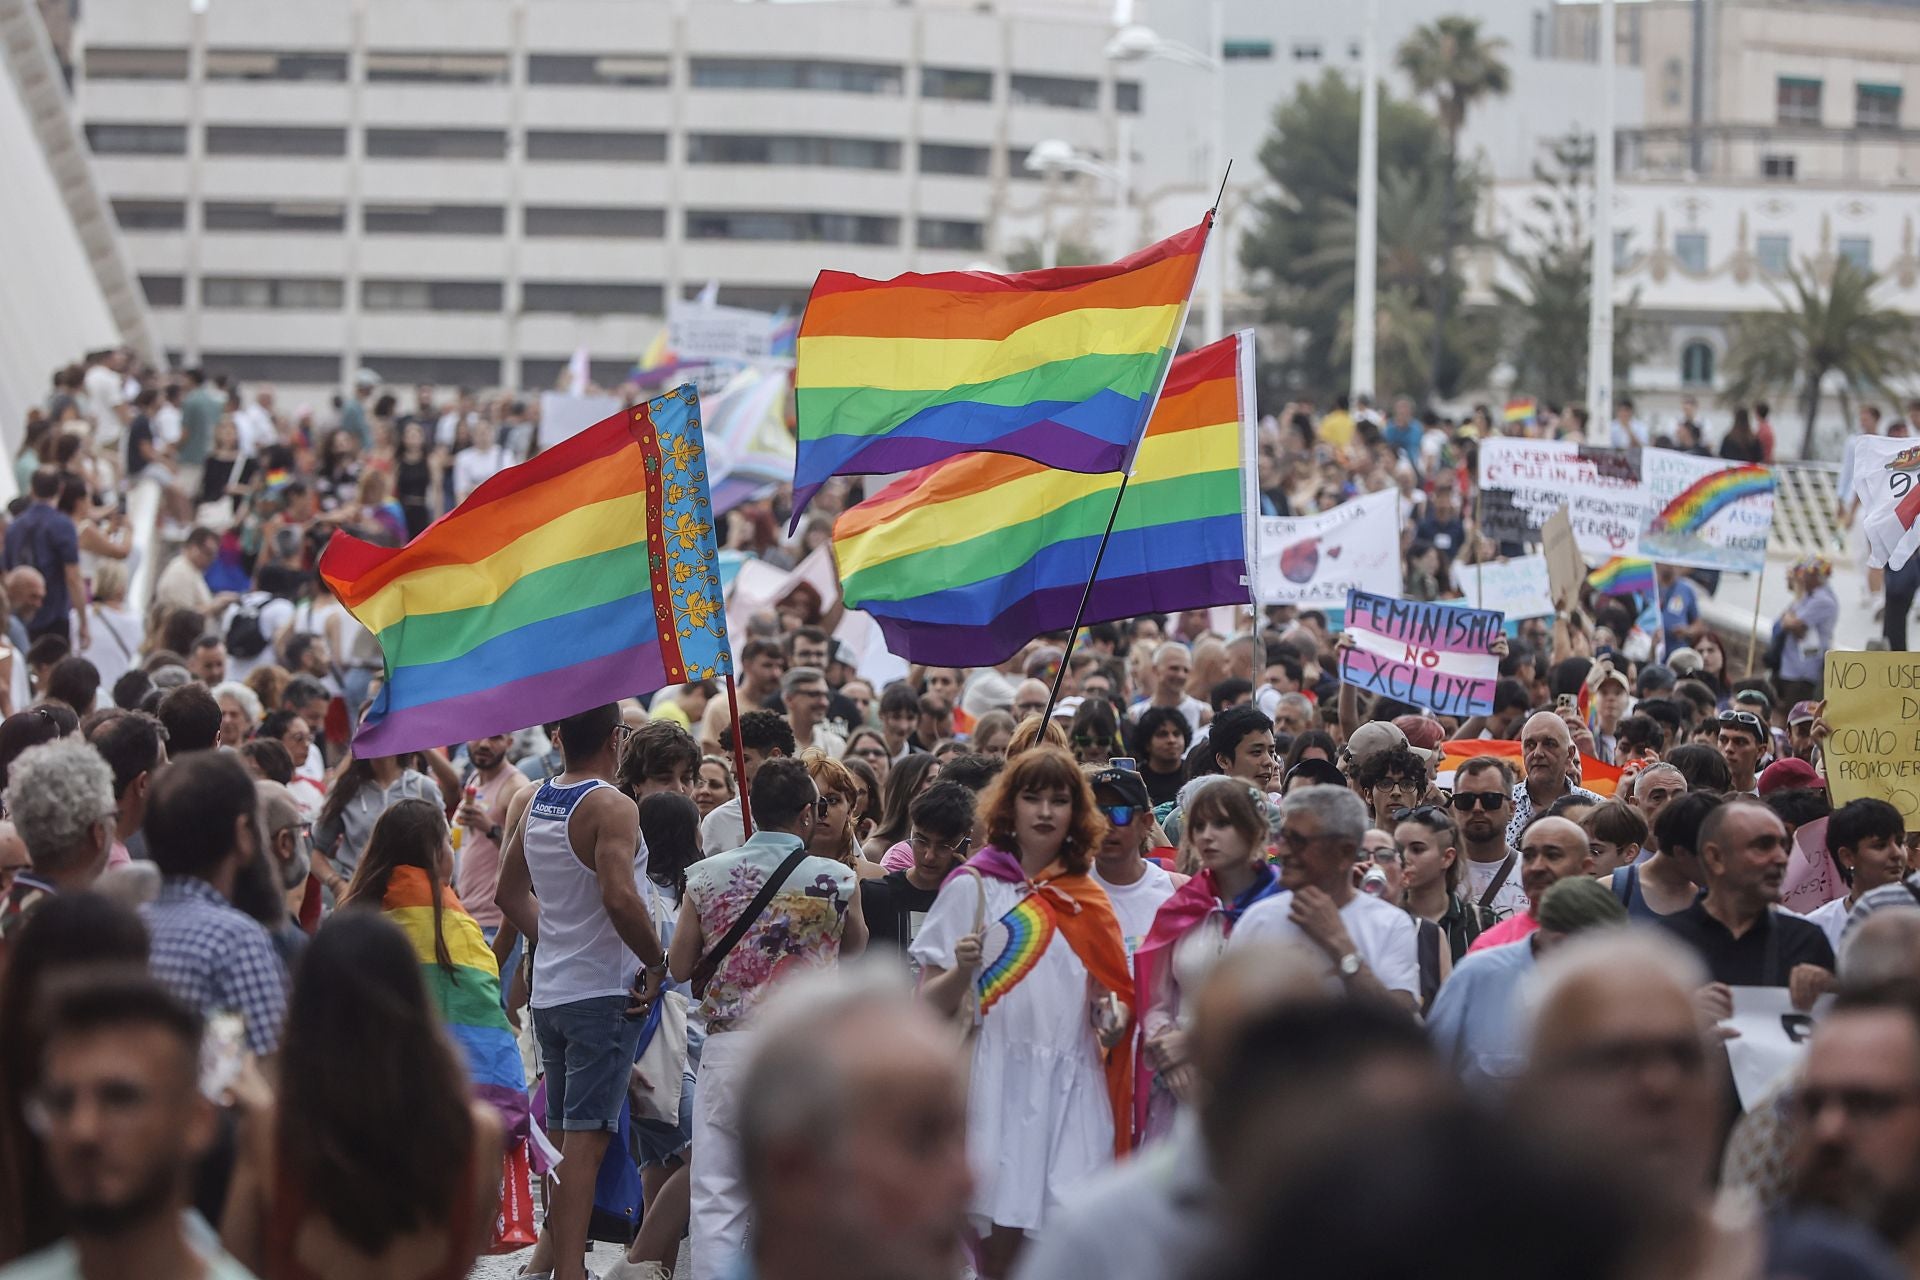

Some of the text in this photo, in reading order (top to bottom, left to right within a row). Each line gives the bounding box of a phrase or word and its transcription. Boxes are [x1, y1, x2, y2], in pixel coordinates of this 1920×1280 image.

[1351, 591, 1502, 653] FEMINISMO
[1405, 644, 1440, 668] NO
[1343, 646, 1486, 714] EXCLUYE
[1830, 661, 1866, 690] NO
[1830, 728, 1897, 755] COMO
[1840, 760, 1920, 781] PROMOVER
[535, 803, 566, 815] ADDICTED
